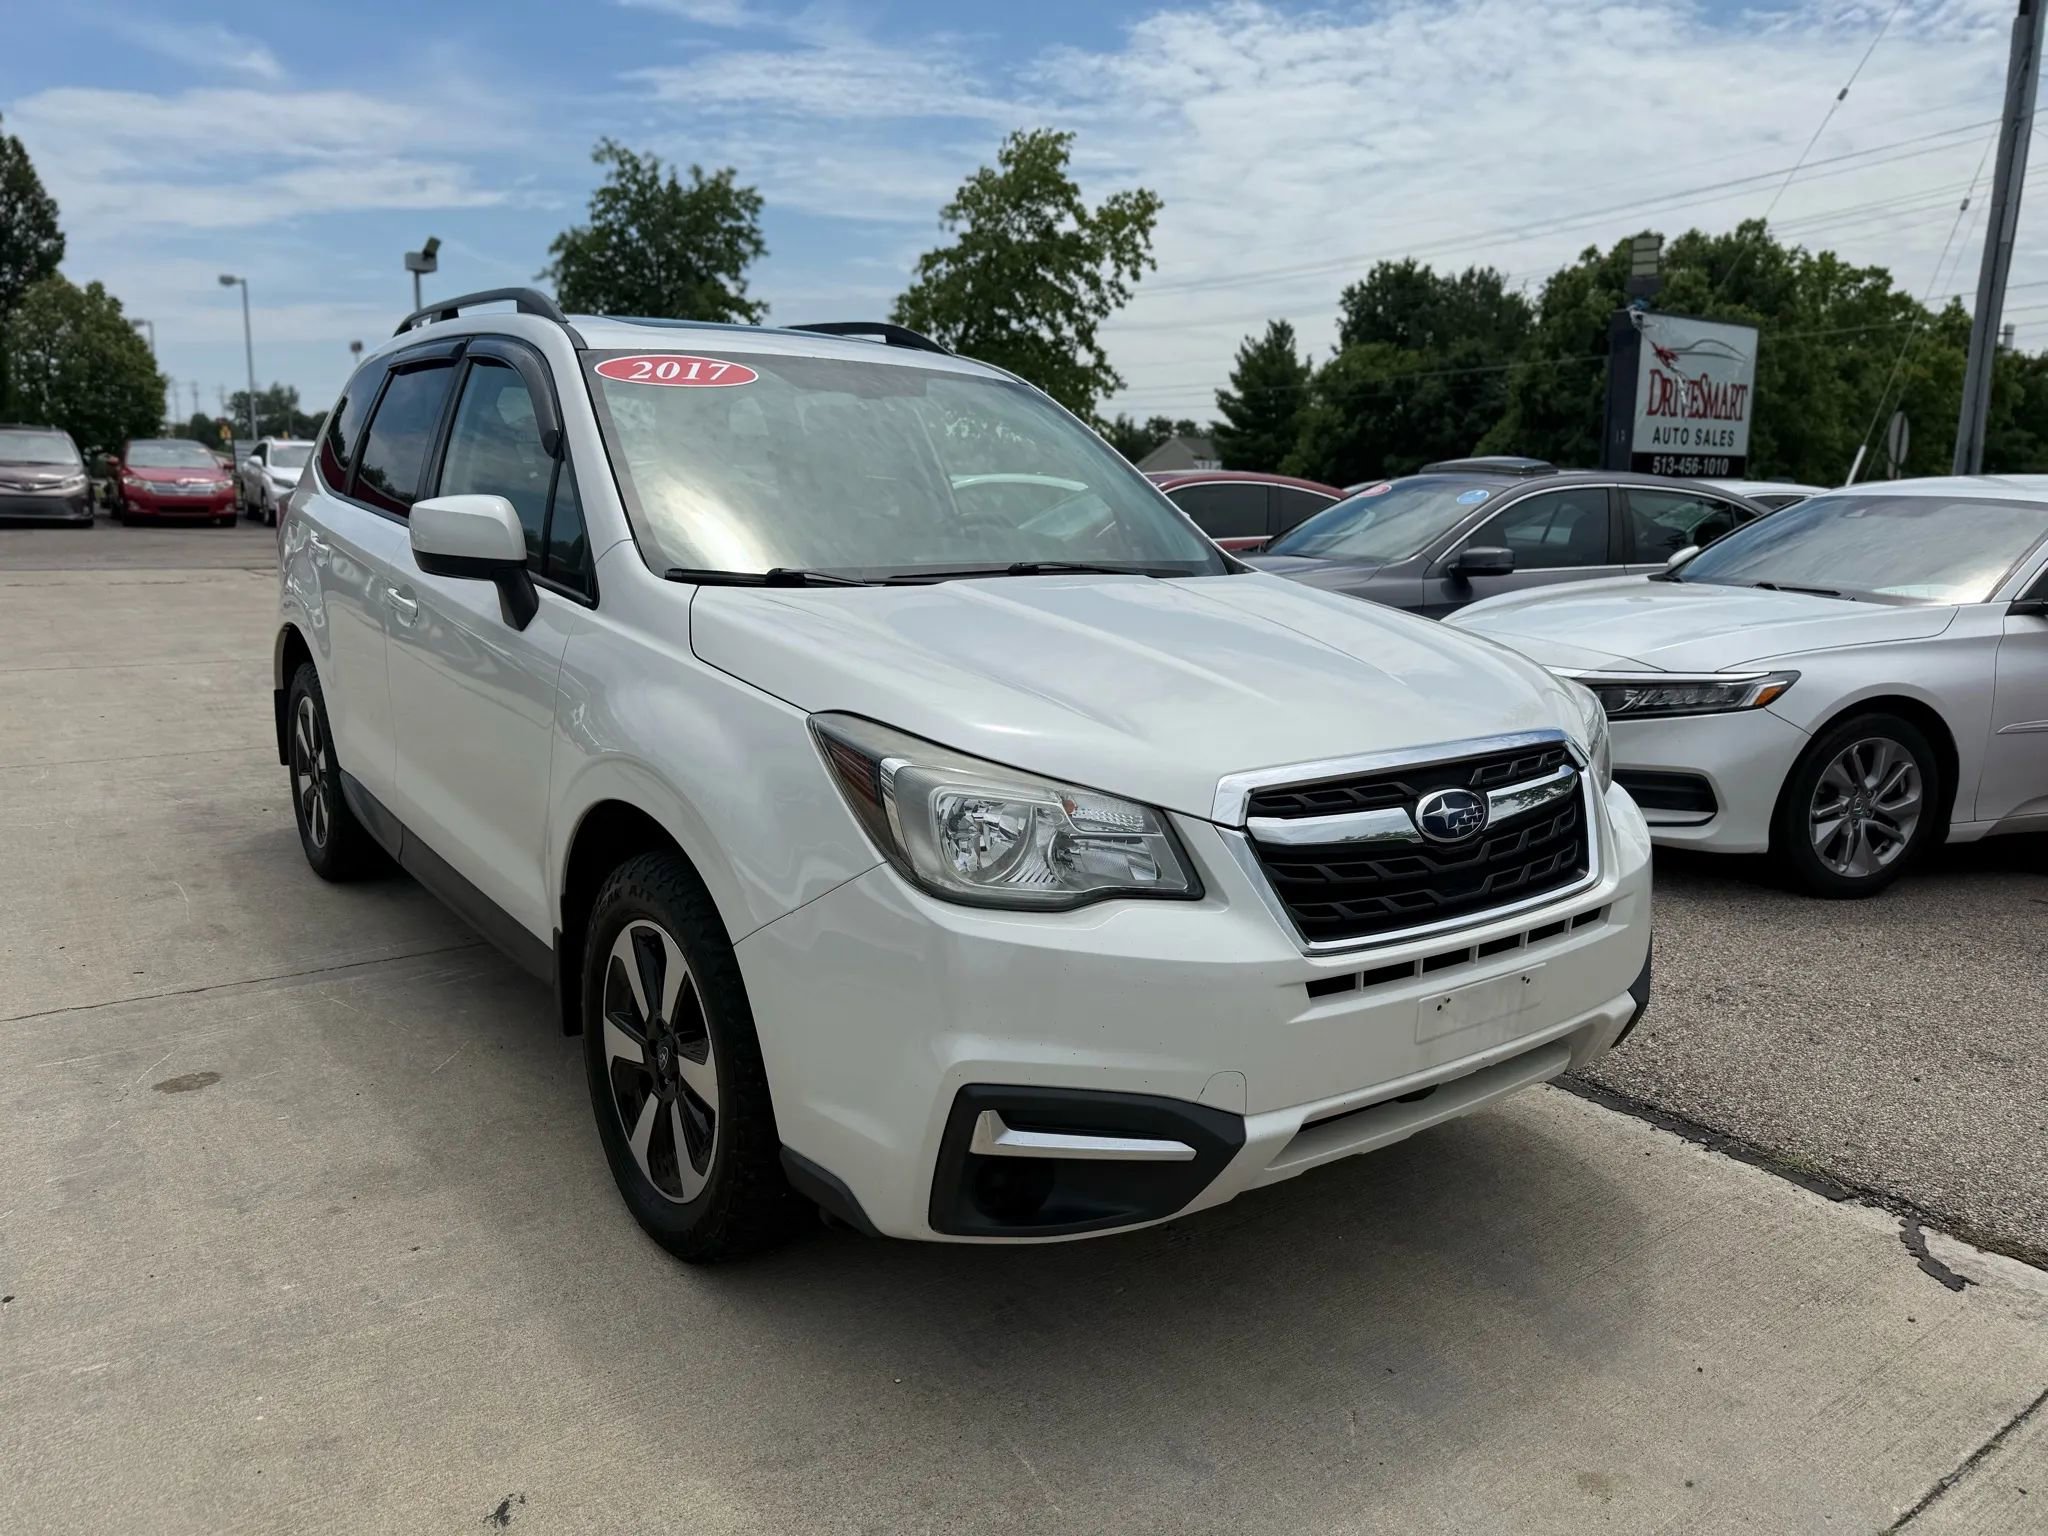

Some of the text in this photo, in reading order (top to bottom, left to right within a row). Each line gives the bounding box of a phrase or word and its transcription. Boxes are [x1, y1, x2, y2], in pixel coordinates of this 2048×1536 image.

[628, 361, 732, 381] 2017
[1652, 426, 1735, 447] AUTO SALES
[1652, 456, 1730, 475] 513-456-1010
